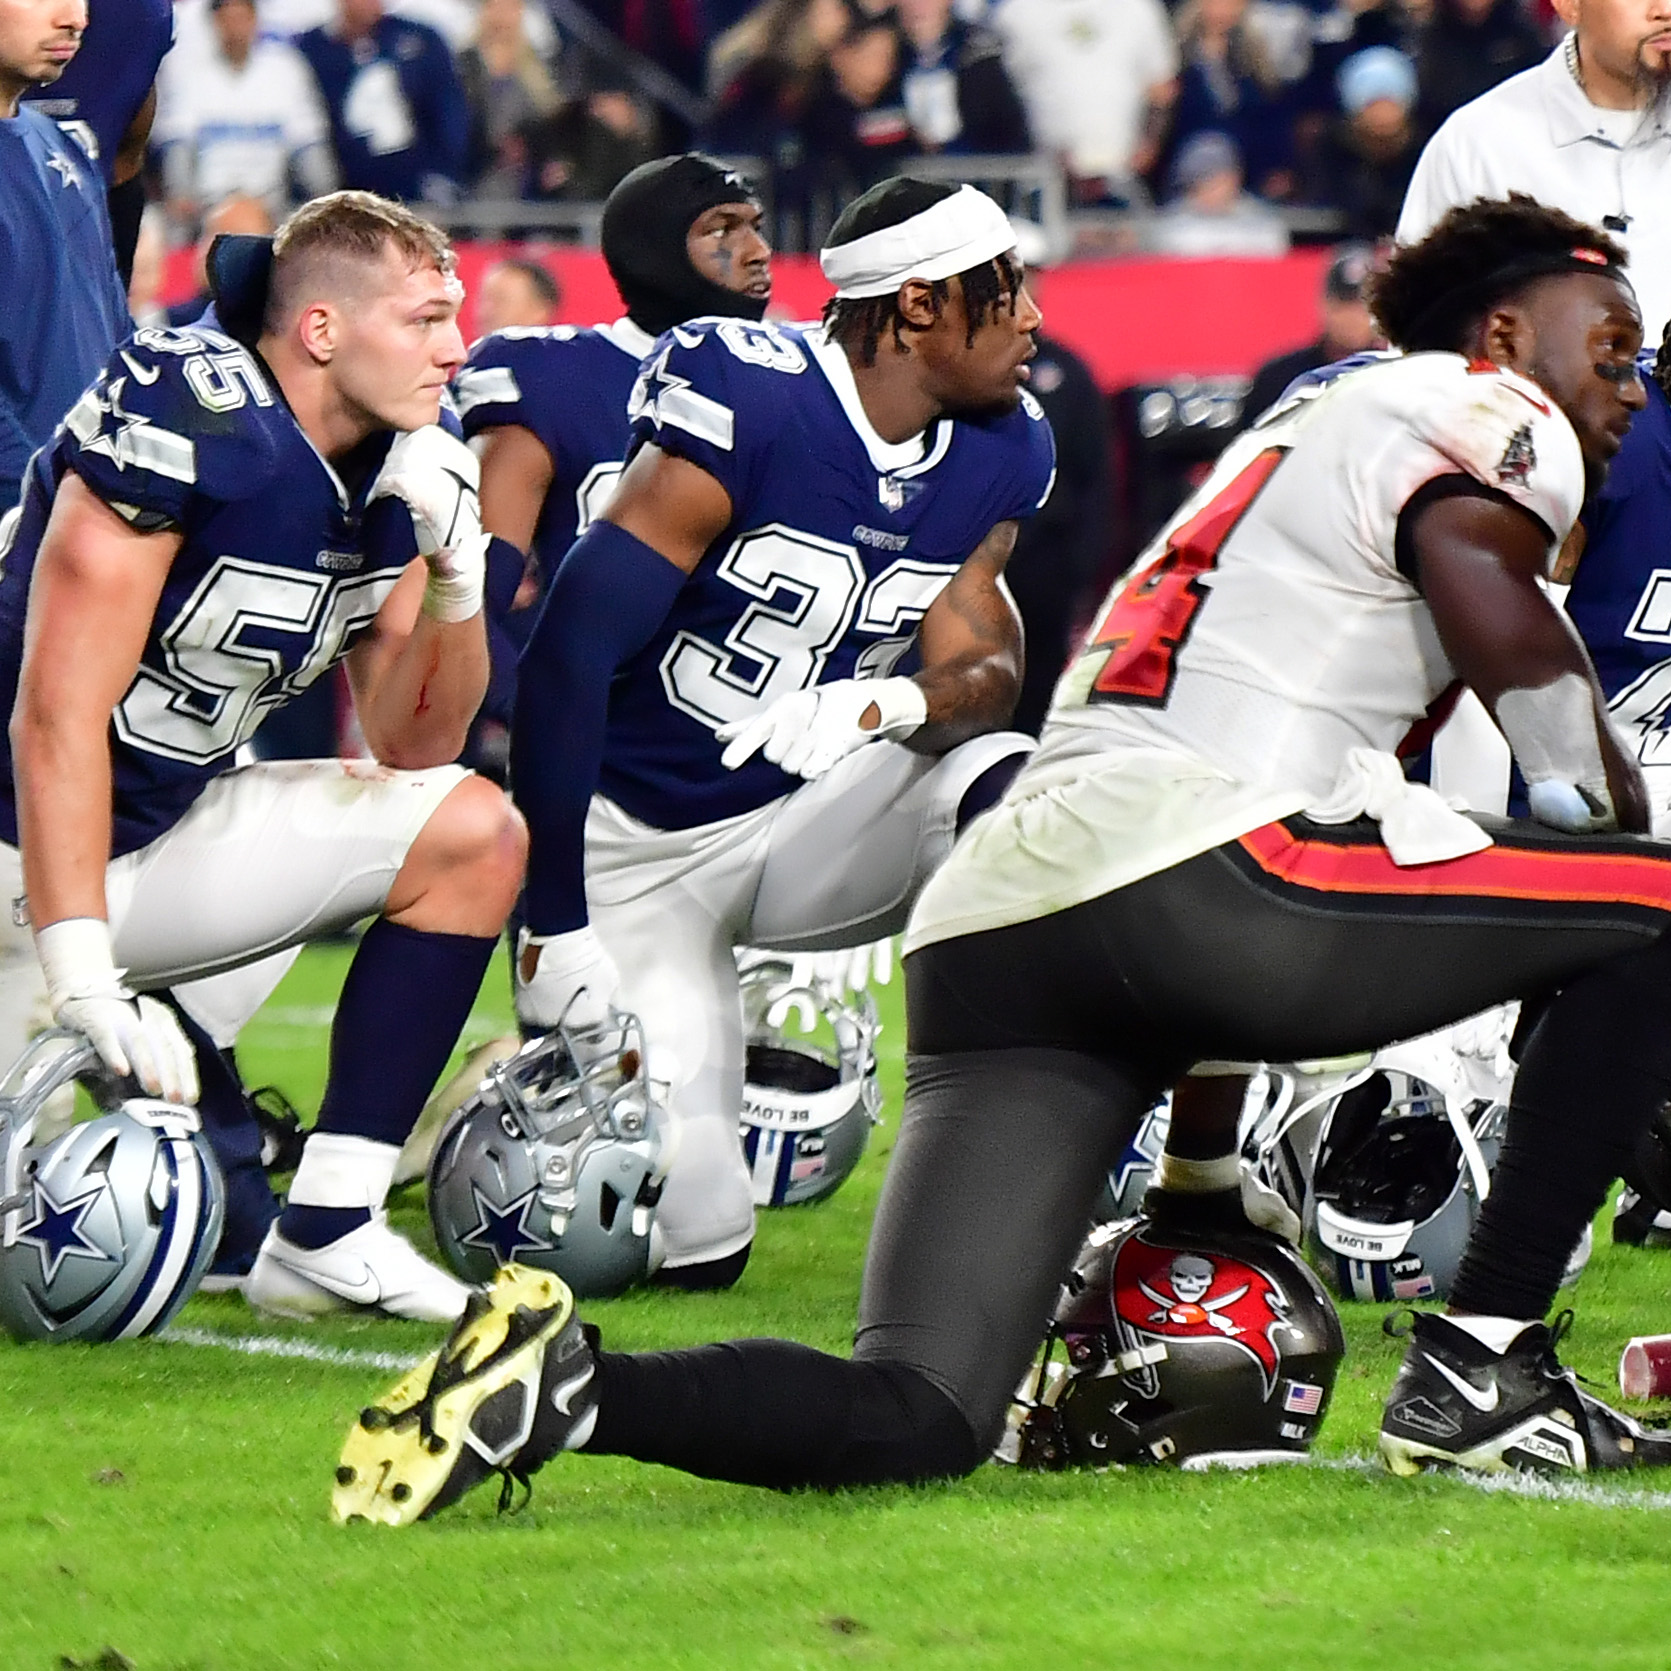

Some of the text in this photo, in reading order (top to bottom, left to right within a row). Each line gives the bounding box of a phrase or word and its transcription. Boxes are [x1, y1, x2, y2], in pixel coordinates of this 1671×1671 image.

[744, 1104, 809, 1122] BE LOVE
[1337, 1235, 1383, 1252] BE LOVE
[1517, 1436, 1567, 1462] ALPHA
